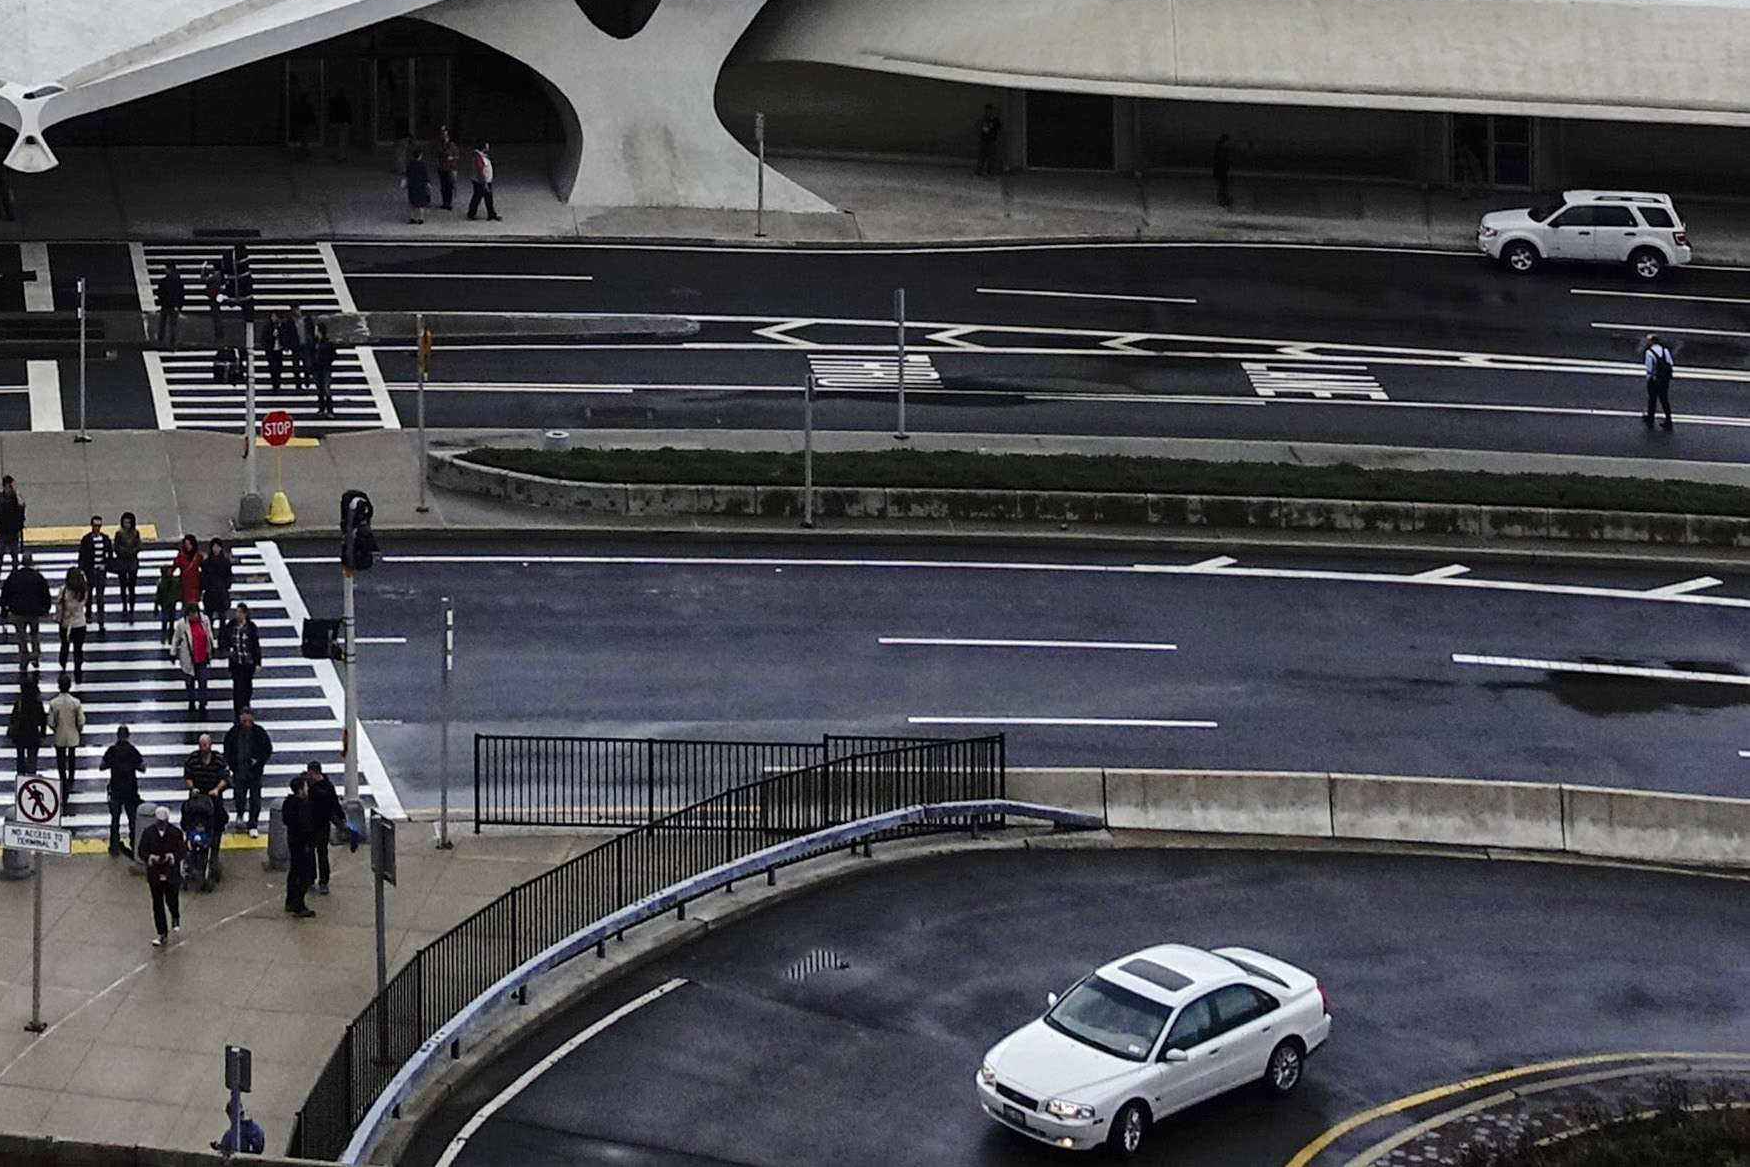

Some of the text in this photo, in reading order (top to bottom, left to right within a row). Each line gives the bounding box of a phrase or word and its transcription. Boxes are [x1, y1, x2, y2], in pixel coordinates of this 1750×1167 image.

[1240, 362, 1390, 400] LANE
[264, 421, 291, 437] STOP
[11, 828, 63, 842] NO ACCESS TO
[17, 837, 51, 848] TERMINAL
